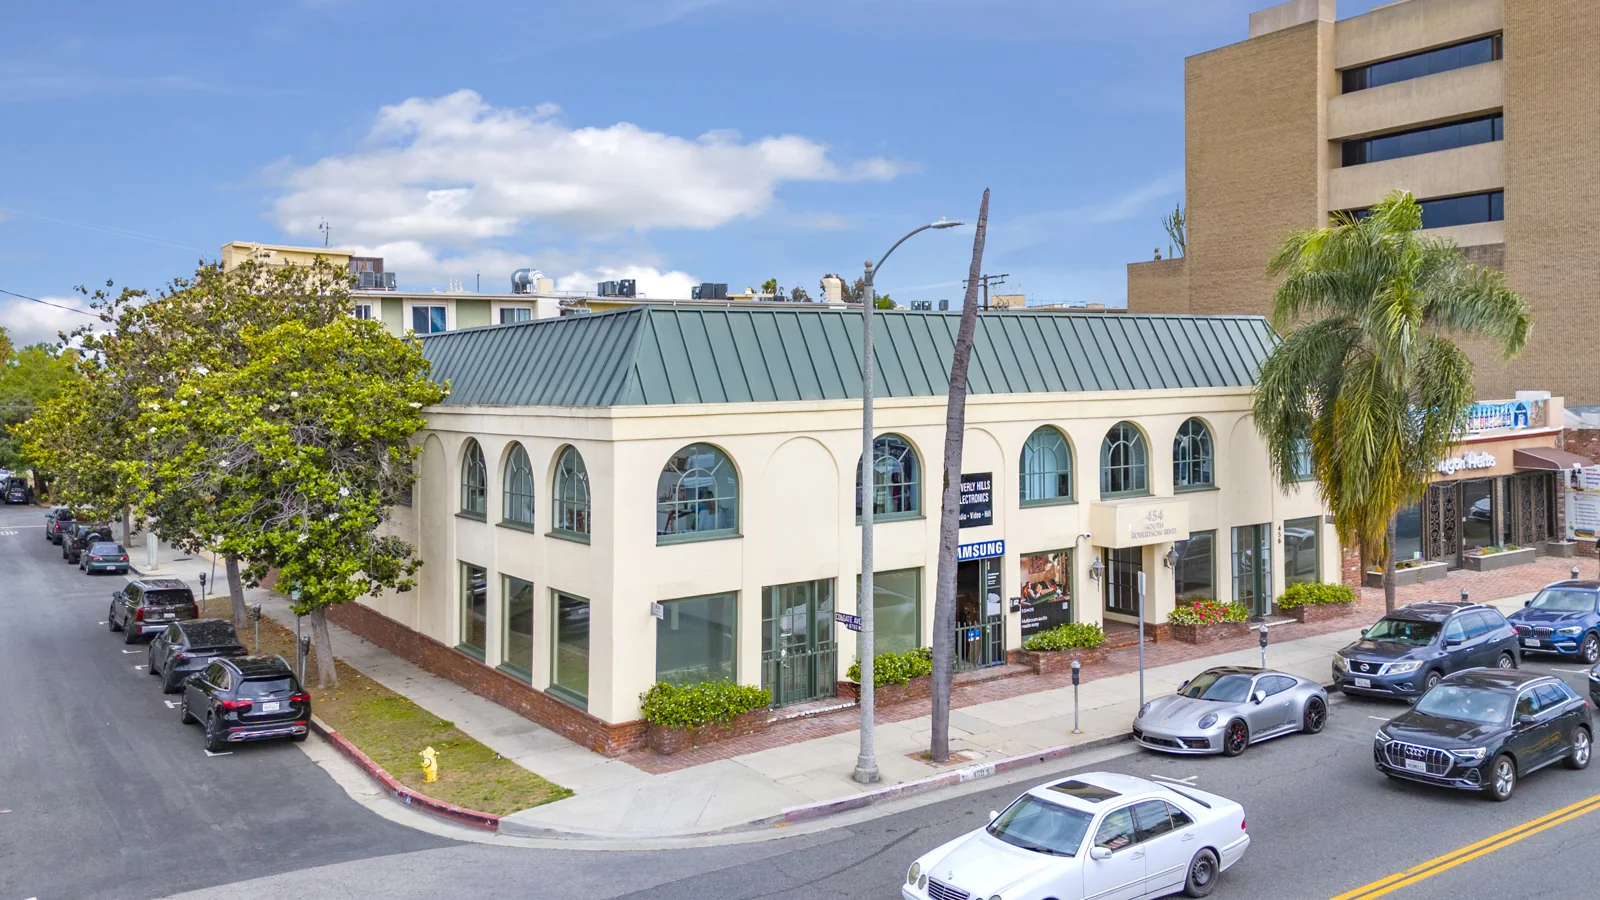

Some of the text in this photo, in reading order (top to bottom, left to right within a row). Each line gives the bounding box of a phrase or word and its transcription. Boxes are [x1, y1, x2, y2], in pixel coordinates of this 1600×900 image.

[1464, 451, 1496, 468] Herbs
[960, 481, 991, 492] VERLY HILLS
[959, 494, 988, 504] LECTRONICS
[969, 511, 982, 520] Video
[1146, 509, 1163, 521] 454
[1145, 522, 1164, 530] SOUTH
[1131, 530, 1162, 539] ROBERTSON
[957, 542, 1002, 558] AMSUNG
[835, 613, 853, 623] COLGATE
[1252, 719, 1296, 735] PORSCHE
